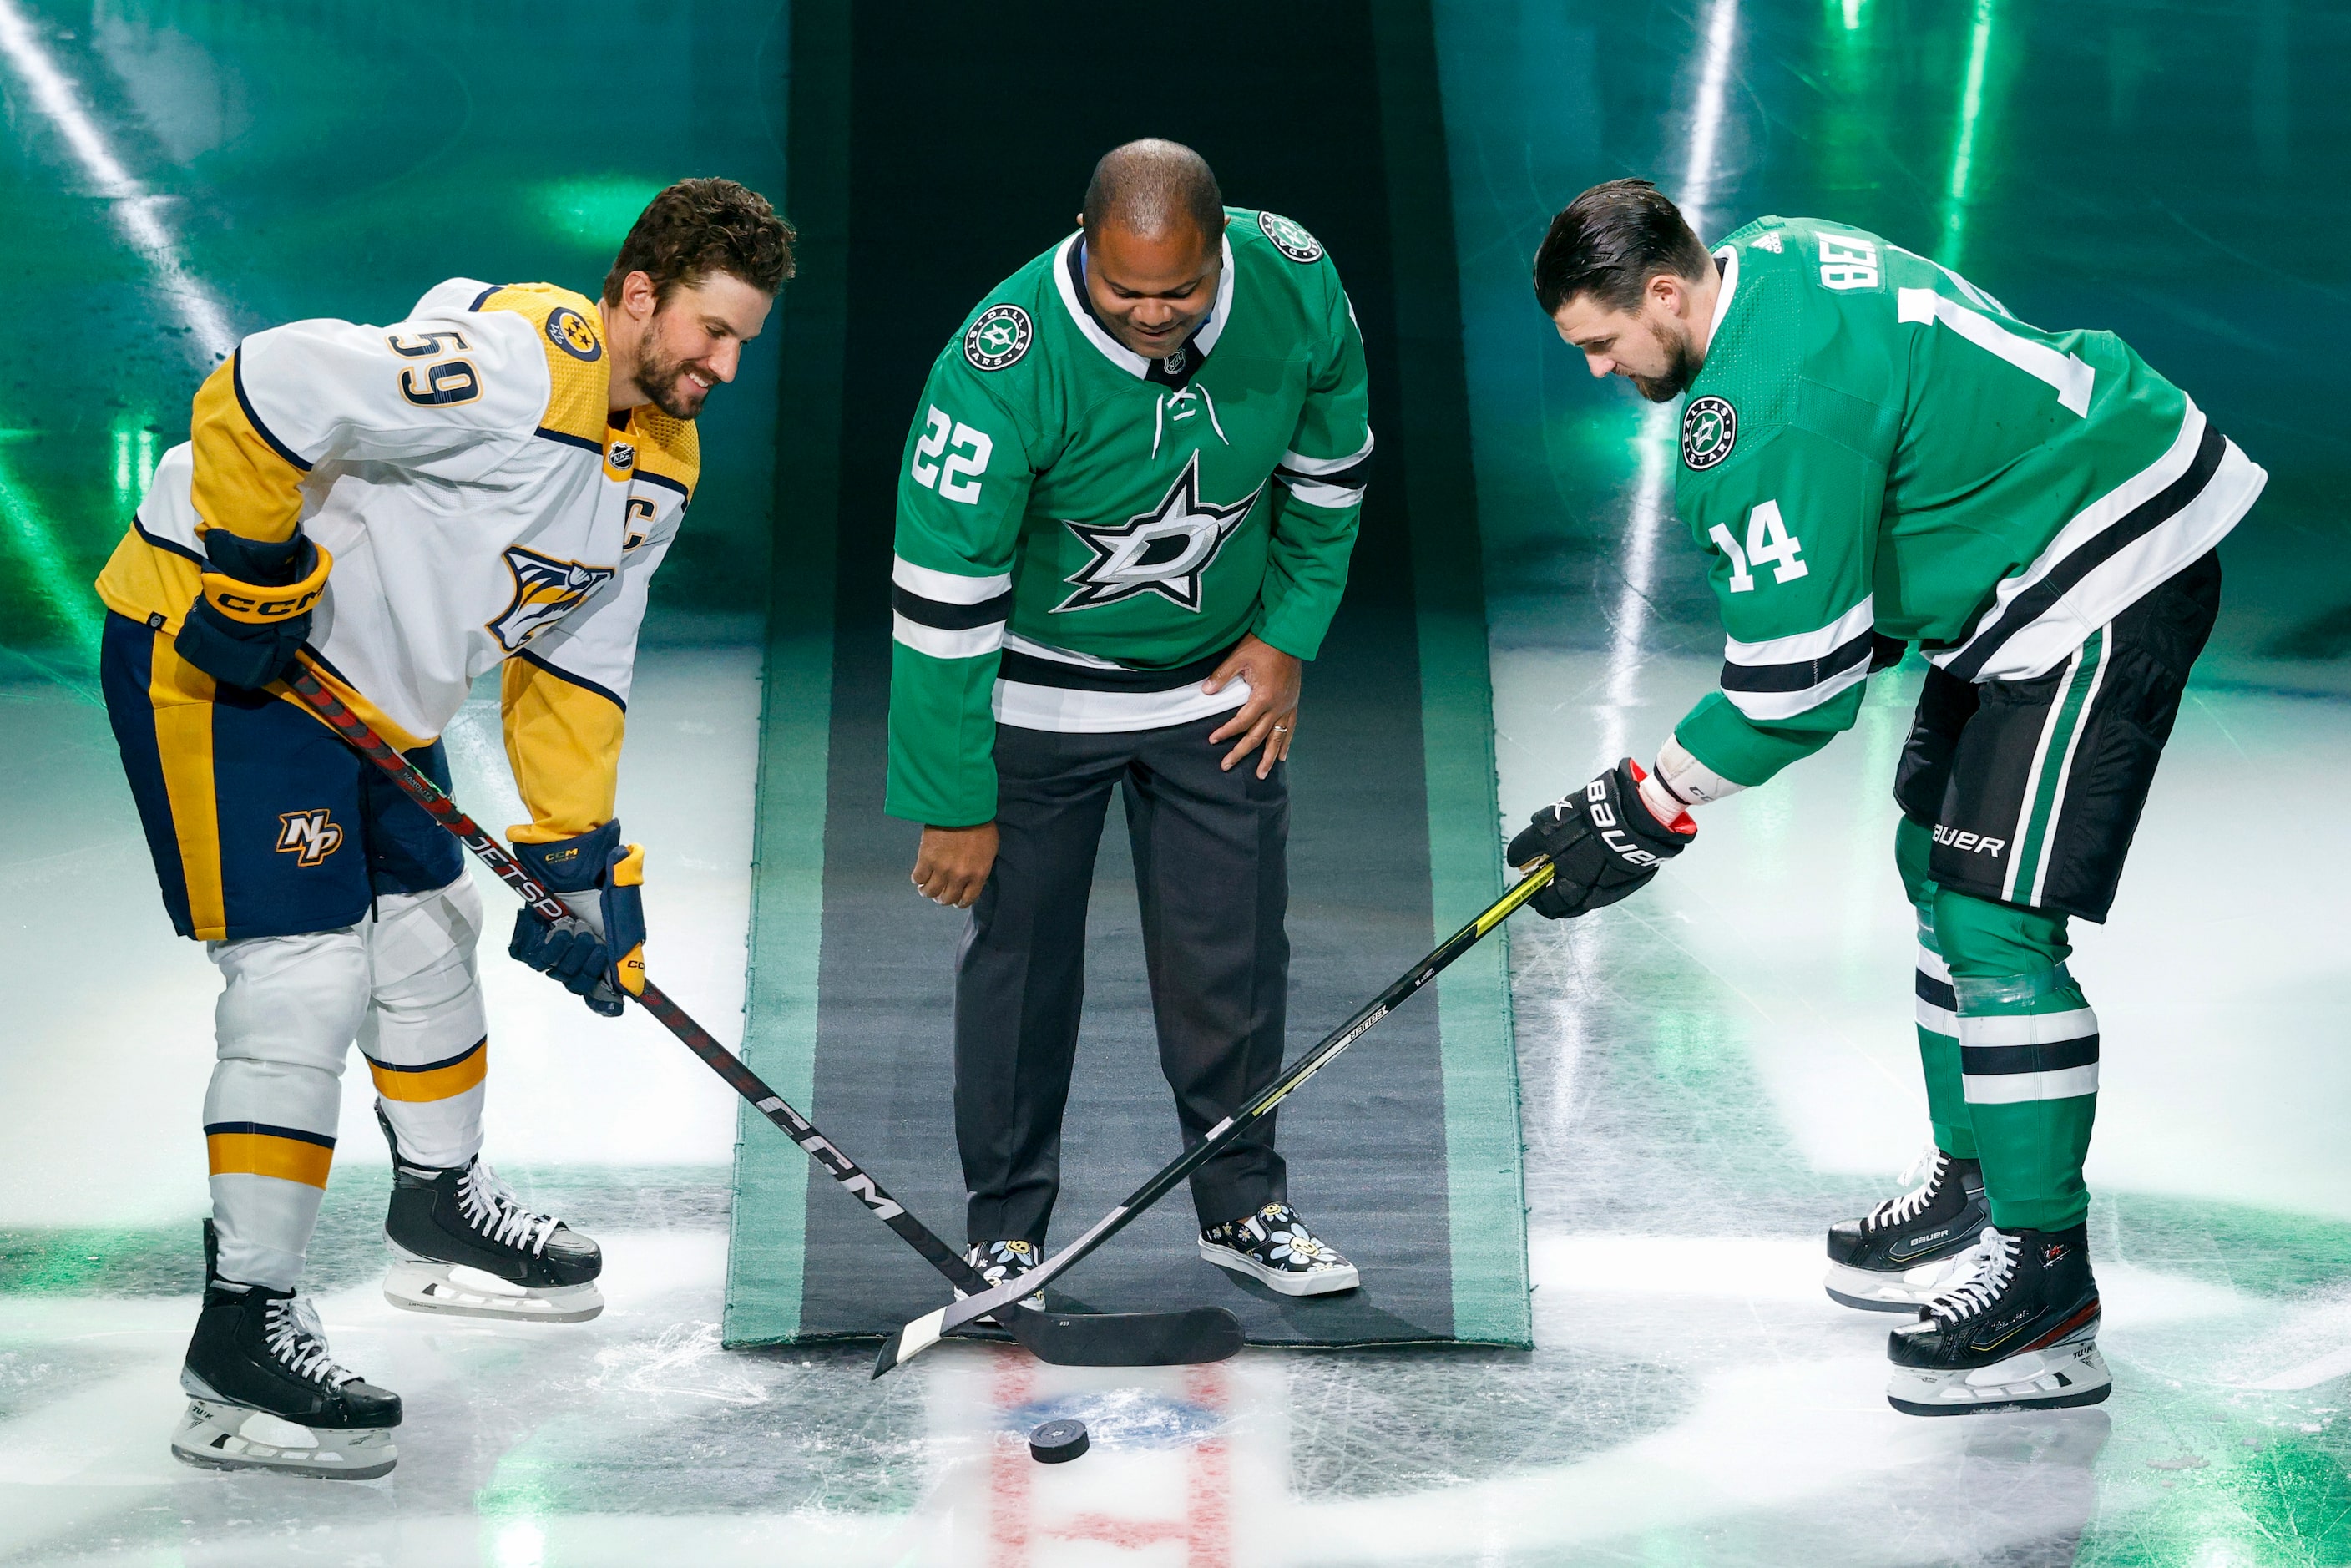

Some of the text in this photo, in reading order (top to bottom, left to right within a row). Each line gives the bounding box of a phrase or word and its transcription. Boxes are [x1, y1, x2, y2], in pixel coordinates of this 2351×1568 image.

[968, 330, 1003, 366] STARS
[987, 308, 1027, 351] DALLAS
[384, 331, 485, 408] 59
[1684, 402, 1729, 443] DALLAS
[911, 402, 993, 506] 22
[1689, 430, 1732, 464] STARS
[623, 495, 659, 553] C
[1708, 498, 1809, 594] 14
[217, 579, 327, 615] CCM
[276, 807, 345, 867] NP
[544, 847, 579, 862] CCM
[1931, 823, 2006, 859] AUER
[459, 835, 573, 927] JETSP
[1350, 1008, 1385, 1039] BAUER
[755, 1095, 906, 1221] CCM
[1910, 1229, 1949, 1247] BAUER
